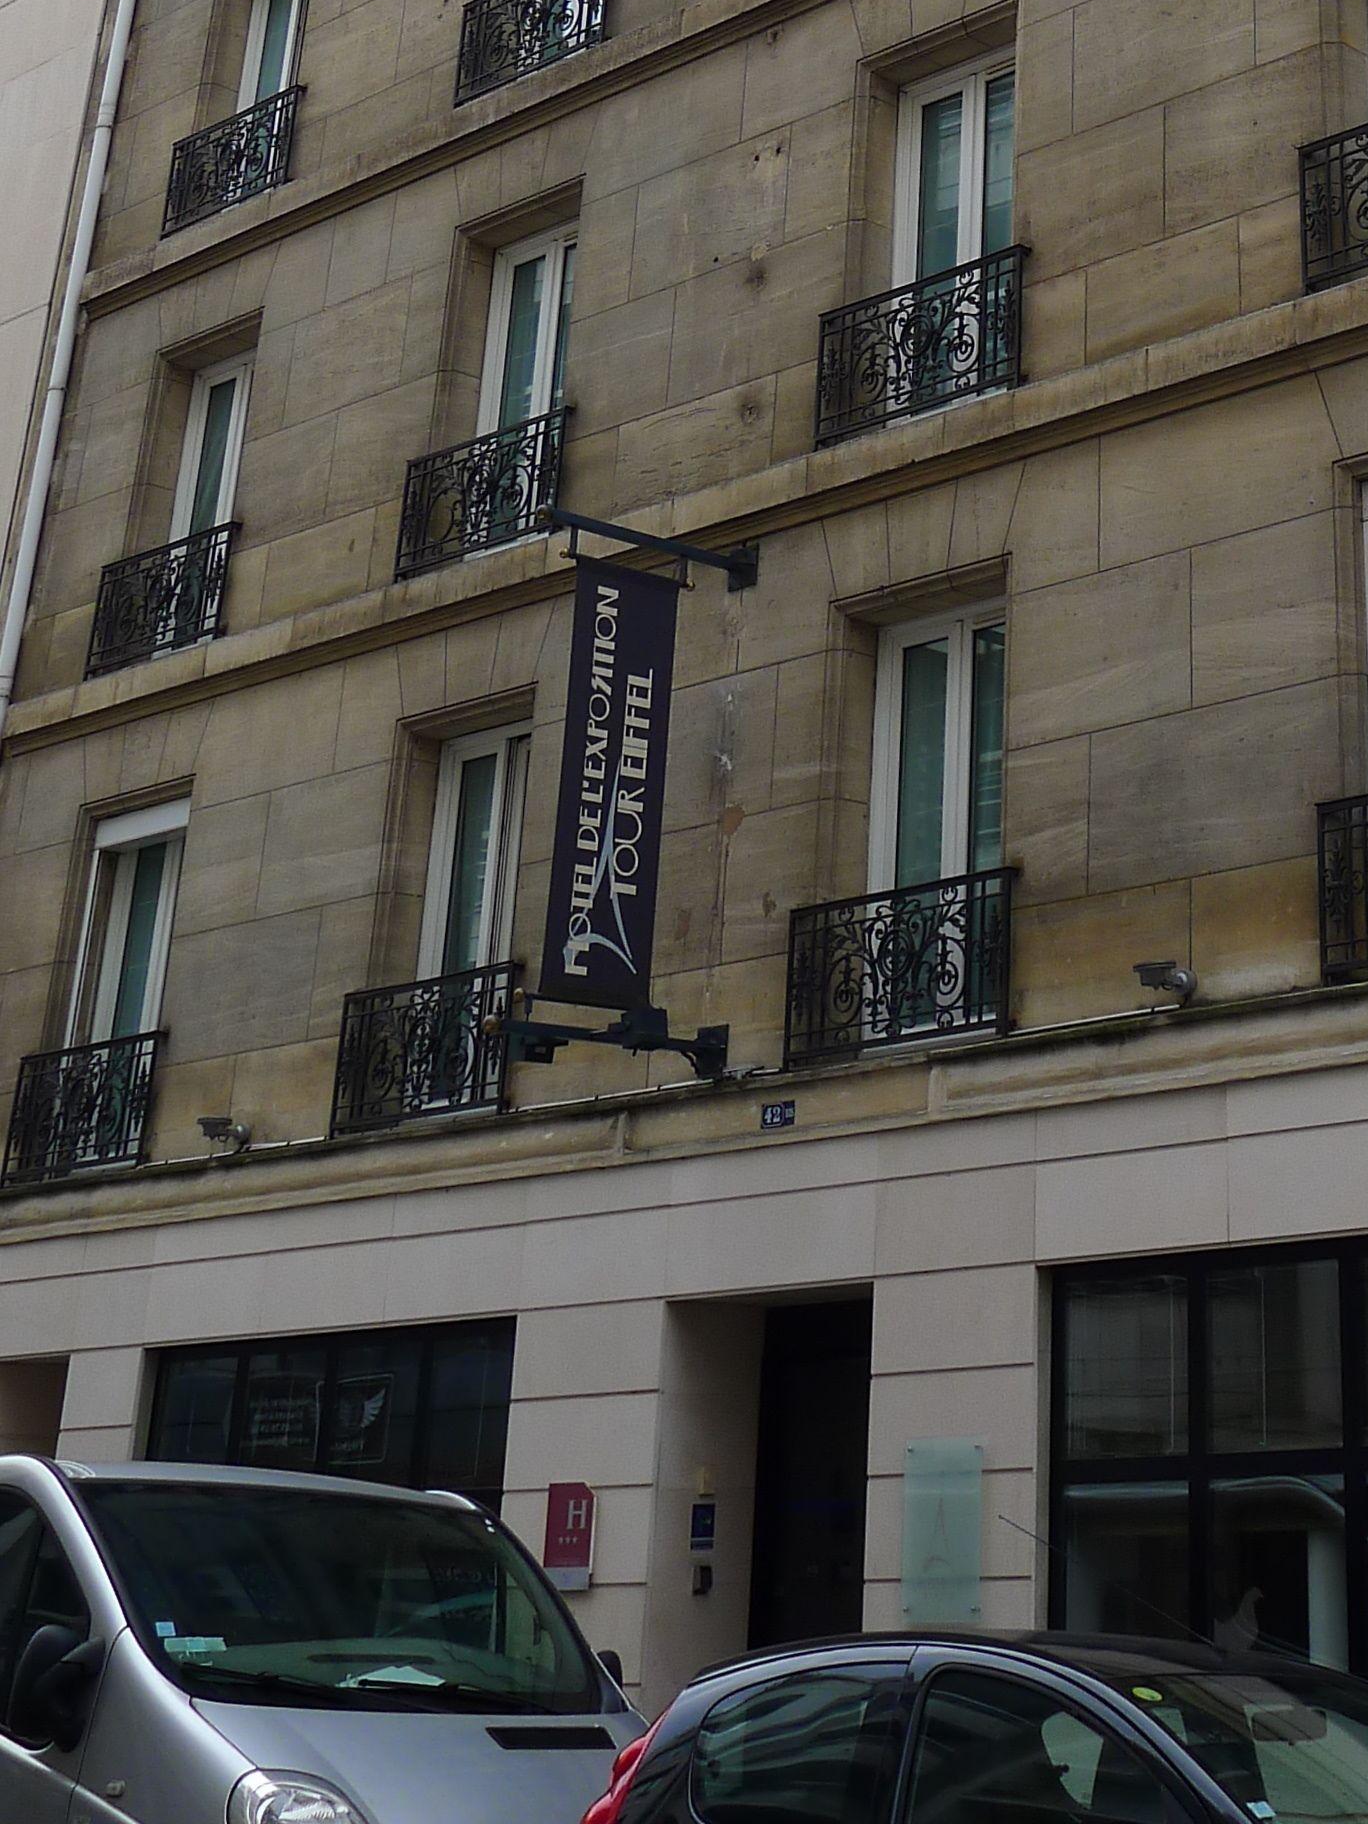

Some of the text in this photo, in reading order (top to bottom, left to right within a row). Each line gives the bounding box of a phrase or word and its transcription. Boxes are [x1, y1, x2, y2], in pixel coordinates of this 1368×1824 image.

[581, 585, 619, 804] L'EXPOSITION
[610, 668, 653, 900] TOUR EIFFEL
[577, 806, 601, 851] DE
[764, 1106, 781, 1124] 42
[565, 1499, 589, 1530] H
